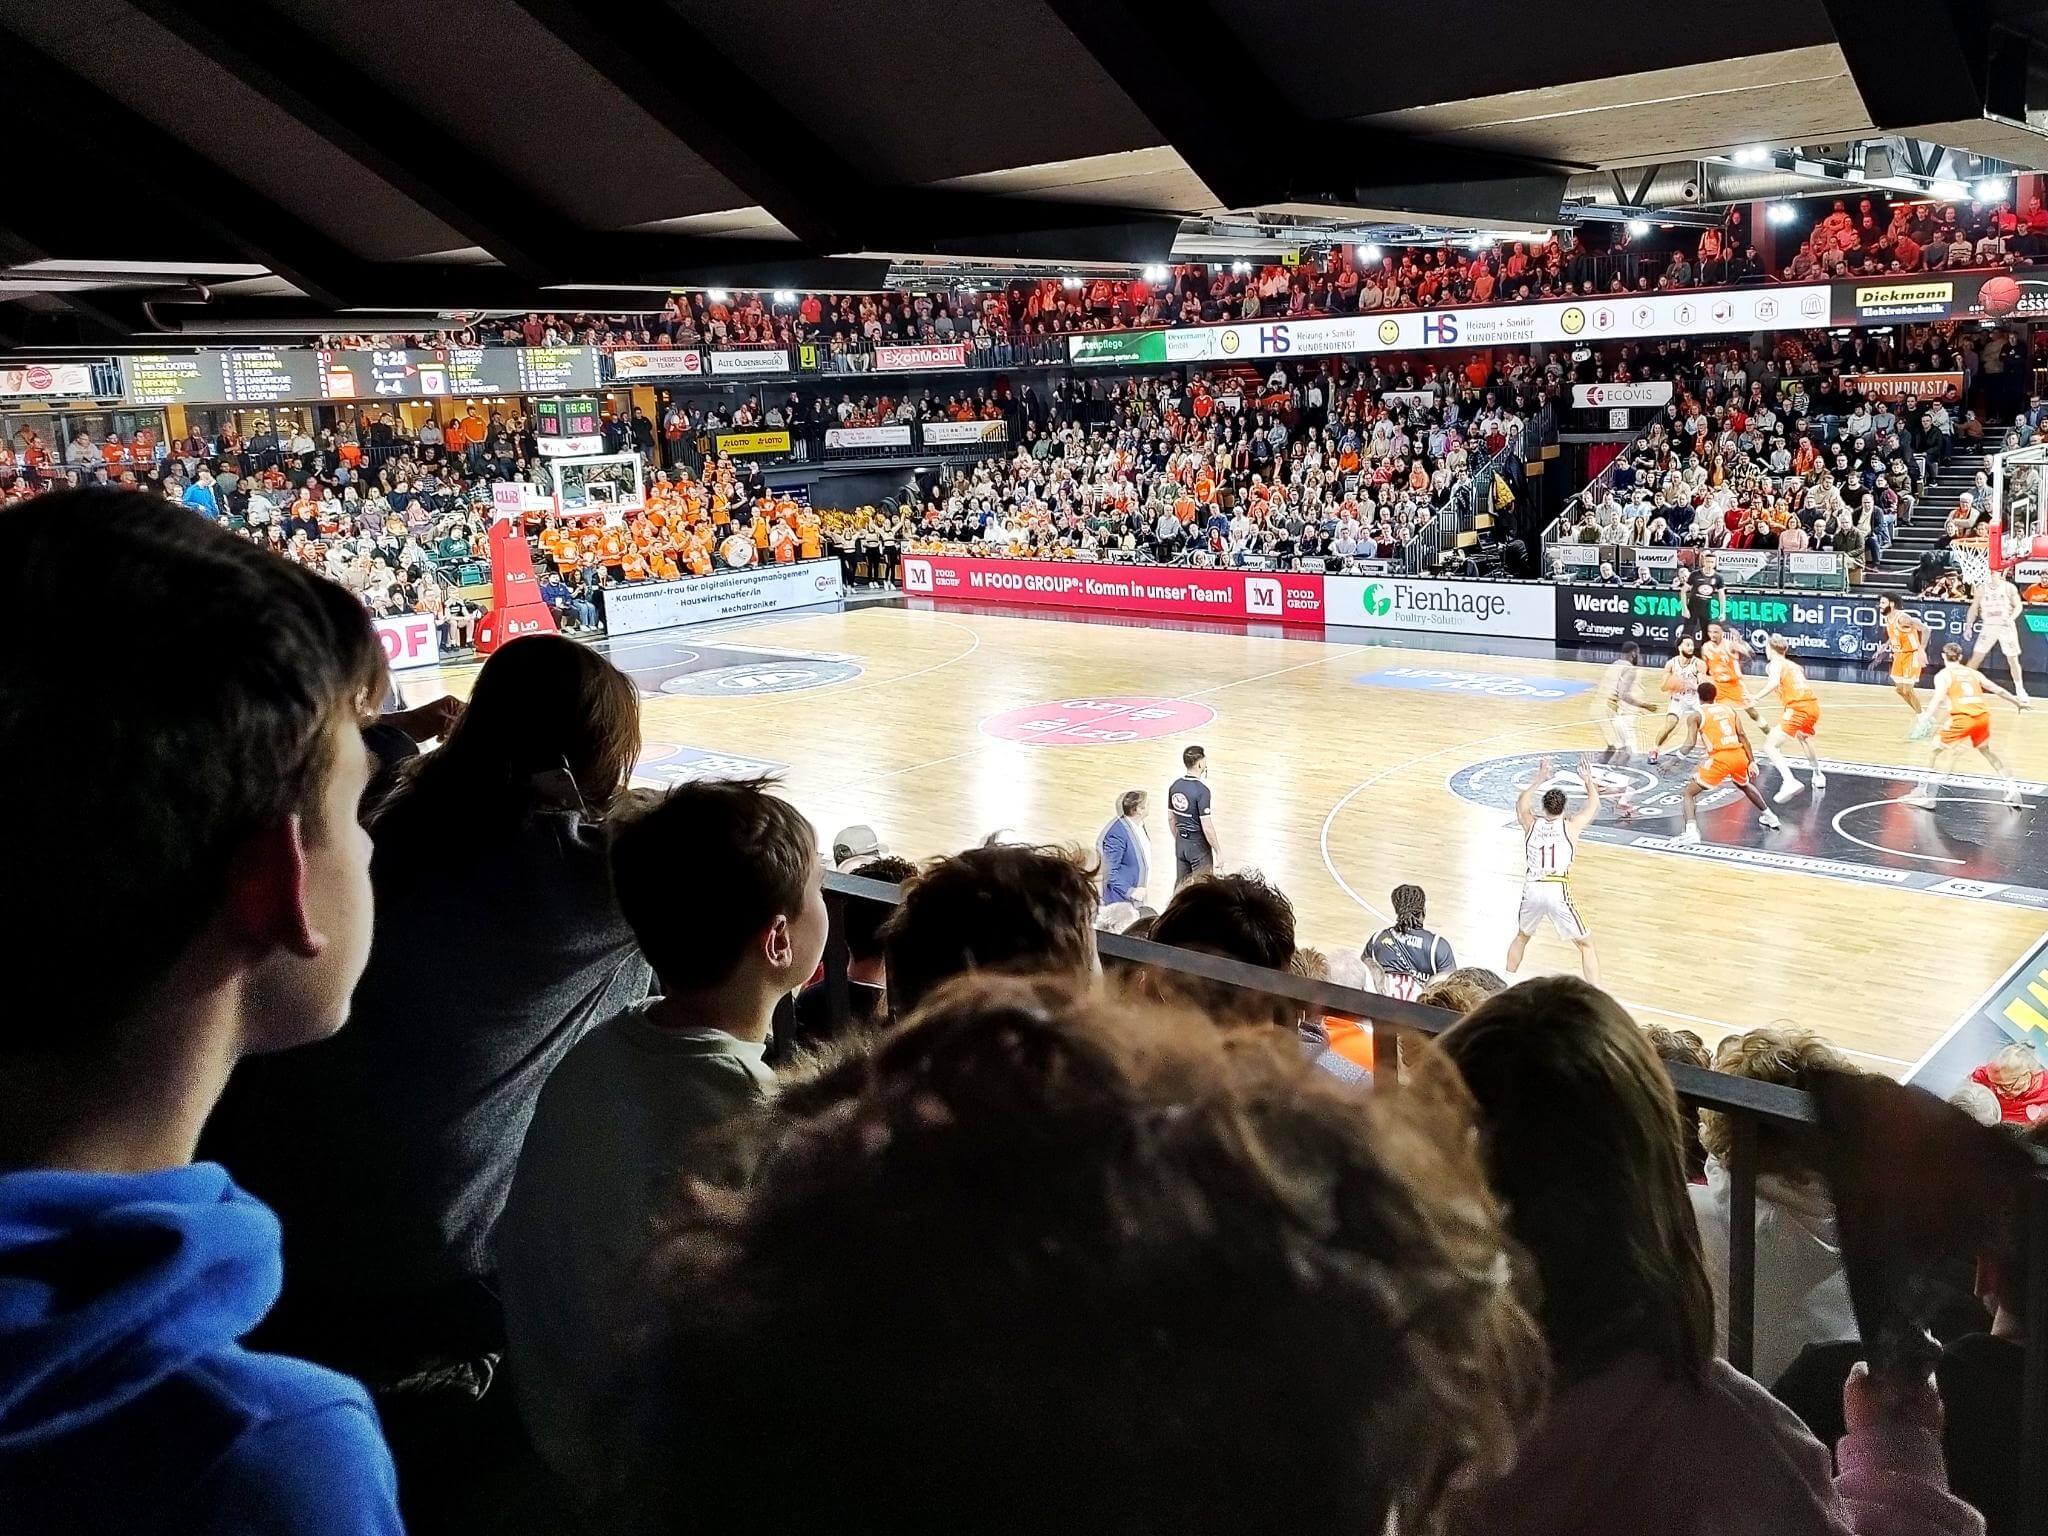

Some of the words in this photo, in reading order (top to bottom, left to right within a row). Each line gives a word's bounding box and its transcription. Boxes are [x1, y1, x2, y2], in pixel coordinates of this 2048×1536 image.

[1862, 303, 1945, 317] Elektrotechnik
[1466, 320, 1497, 331] Heizung
[1507, 317, 1534, 327] Sanitär
[1297, 331, 1323, 341] Heizung
[1332, 328, 1355, 338] Sanitär
[1466, 330, 1534, 343] KUNDENDIENST
[1298, 341, 1355, 353] KUNDENDIENST
[718, 359, 734, 368] ALTE
[734, 357, 780, 368] OLDENBURGER
[884, 349, 957, 366] ExxonMobil
[1606, 388, 1652, 401] ECOVIS
[911, 568, 926, 584] M
[935, 569, 956, 578] FOOD
[686, 583, 699, 593] für
[970, 571, 983, 587] M
[985, 572, 1023, 590] FOOD
[1086, 577, 1129, 598] Komm
[1131, 580, 1145, 598] in
[1147, 585, 1187, 601] unser
[1188, 584, 1233, 604] Team!
[1287, 588, 1315, 599] FOOD
[1253, 586, 1275, 607] M
[1394, 584, 1511, 621] Fienhage.
[721, 600, 777, 614] Mechatroniker
[1573, 594, 1630, 614] Werde
[1792, 603, 1824, 625] bei
[1646, 626, 1670, 638] IGG
[1538, 843, 1555, 869] 11
[1949, 882, 1985, 893] GS
